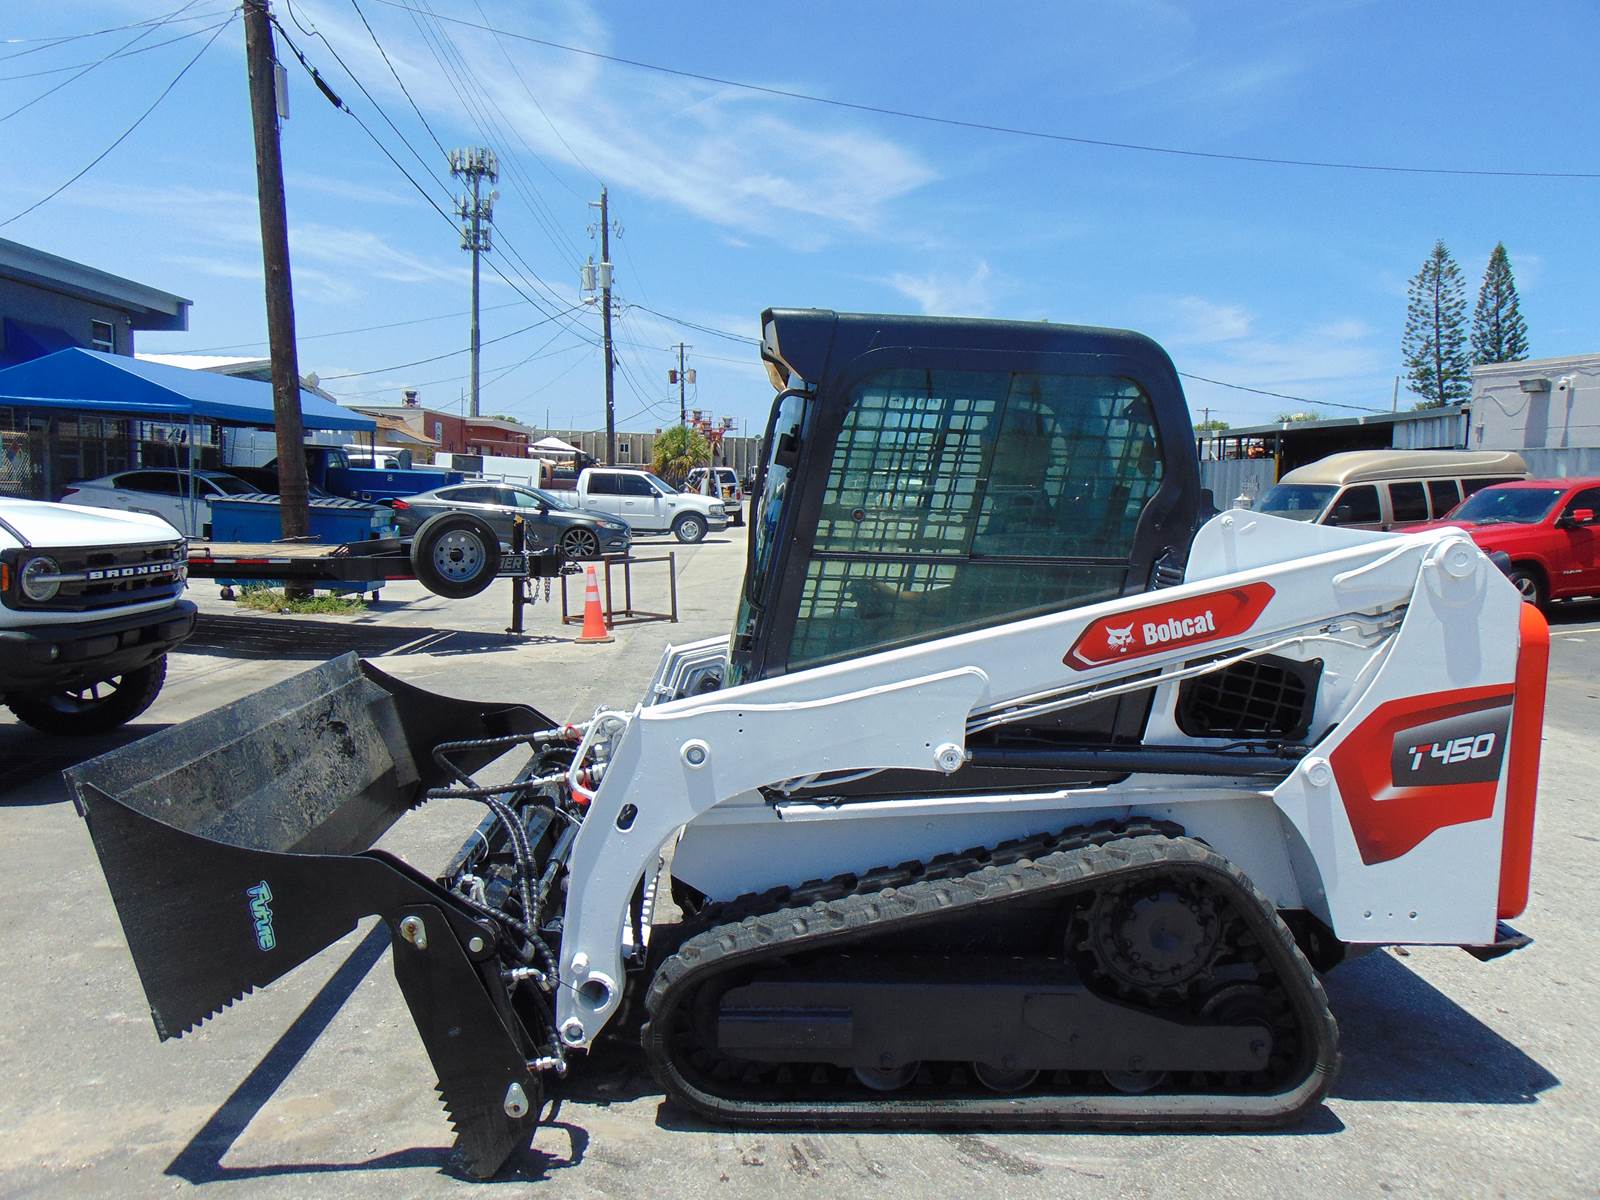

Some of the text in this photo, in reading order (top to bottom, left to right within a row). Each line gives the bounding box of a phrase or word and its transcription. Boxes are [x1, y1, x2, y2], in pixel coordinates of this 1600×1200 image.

[89, 563, 172, 580] BRONCO
[499, 557, 522, 569] IER
[1143, 610, 1216, 646] Bobcat
[1409, 733, 1495, 770] T450
